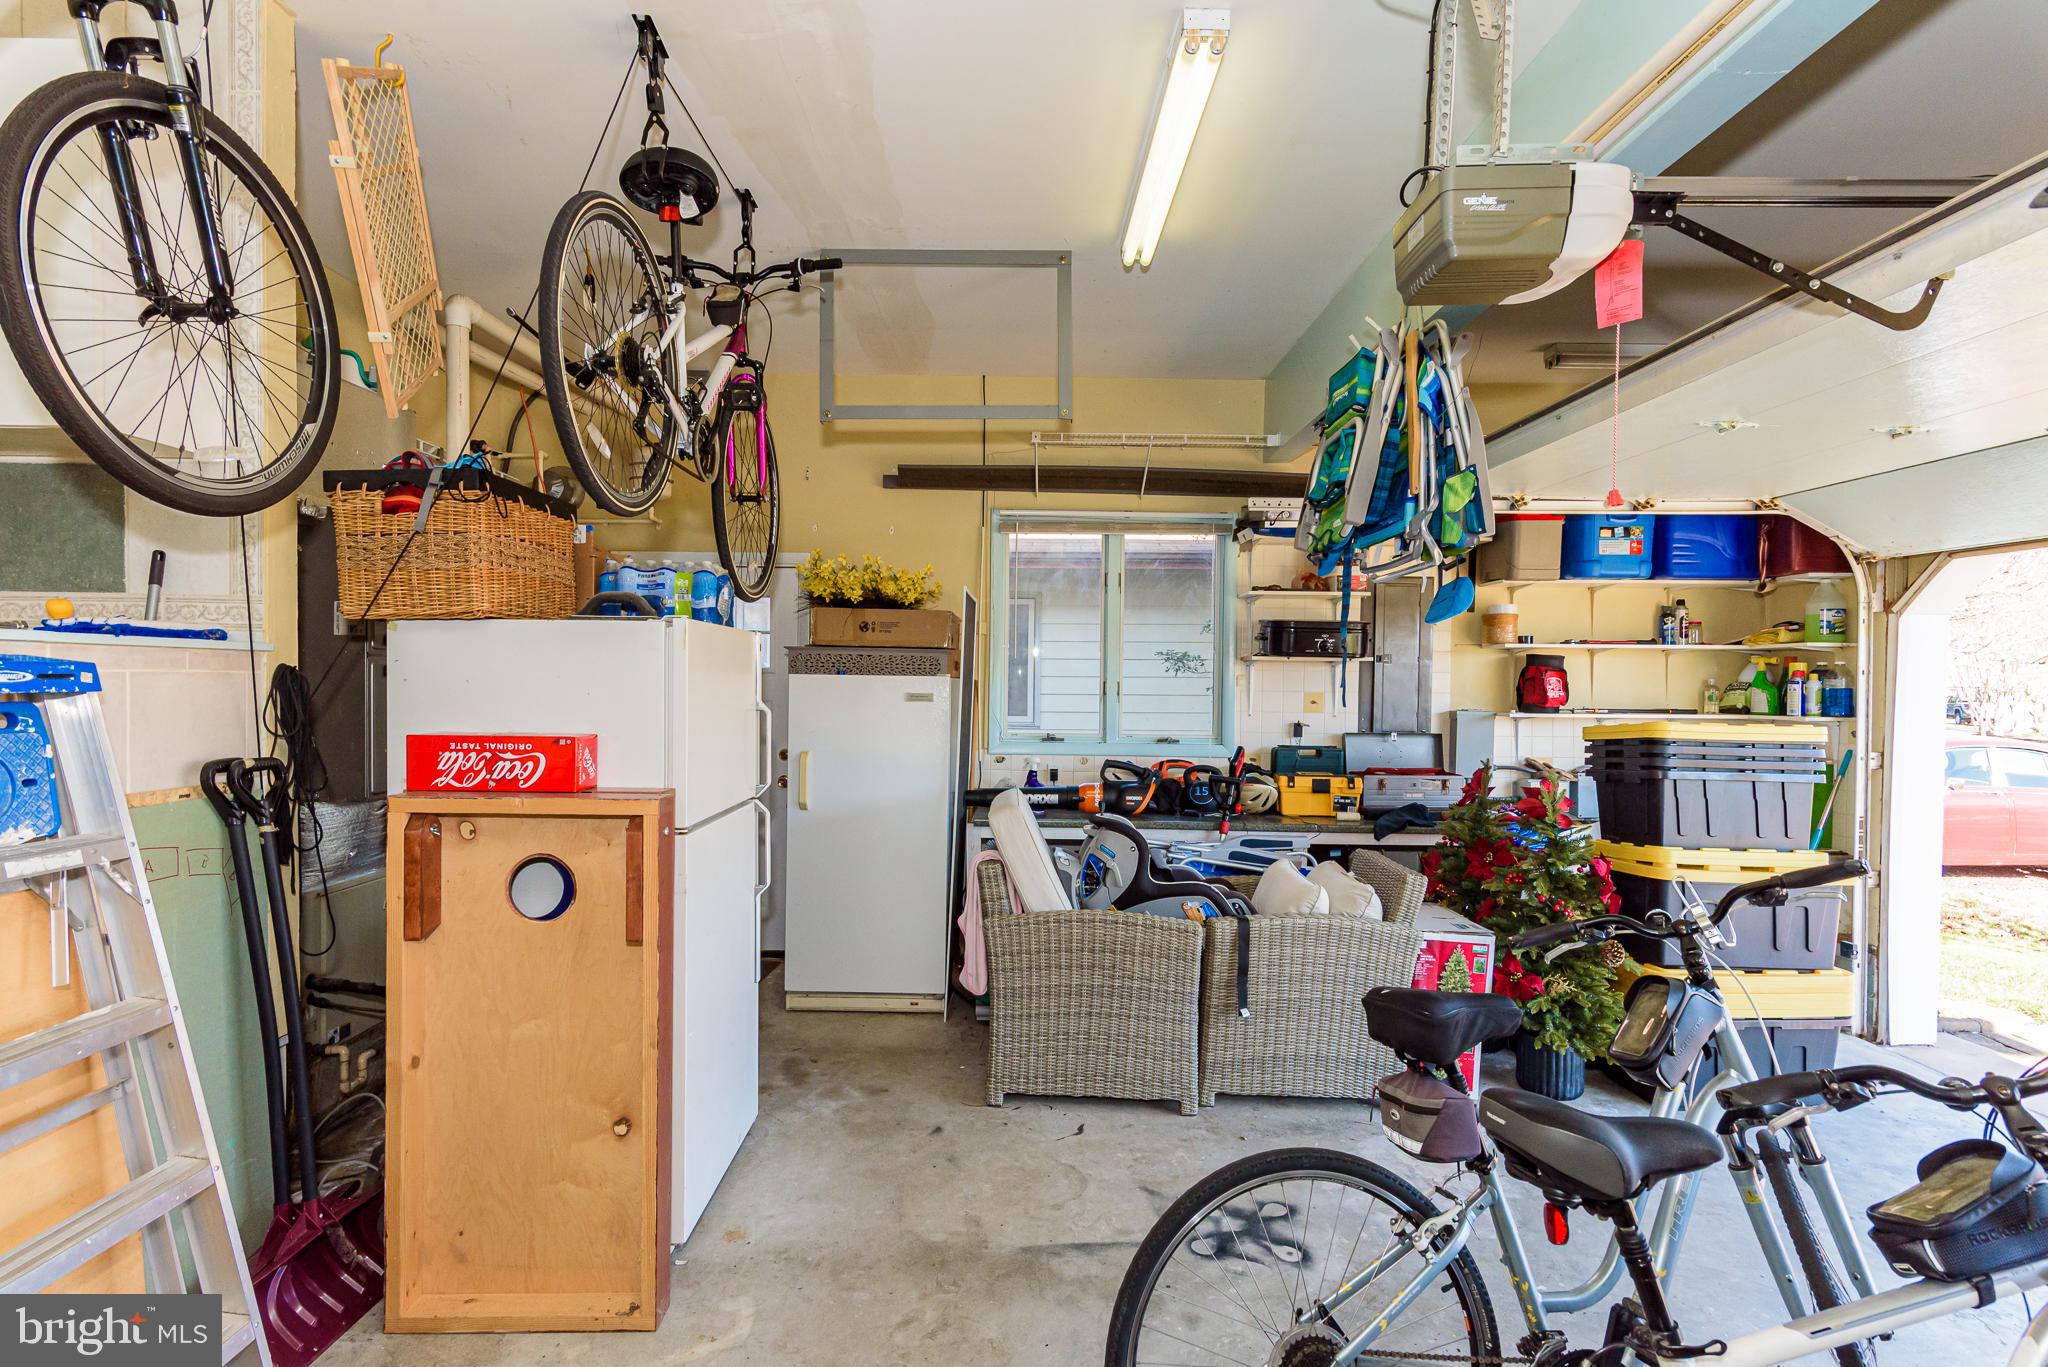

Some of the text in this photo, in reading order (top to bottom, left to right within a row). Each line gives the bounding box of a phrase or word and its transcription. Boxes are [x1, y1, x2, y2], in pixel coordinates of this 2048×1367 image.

[263, 444, 302, 481] SCHWINN
[449, 742, 532, 750] ORIGINAL TASTE
[431, 751, 547, 789] Coca-Cola
[1195, 786, 1209, 796] 15
[1023, 793, 1057, 805] ORX
